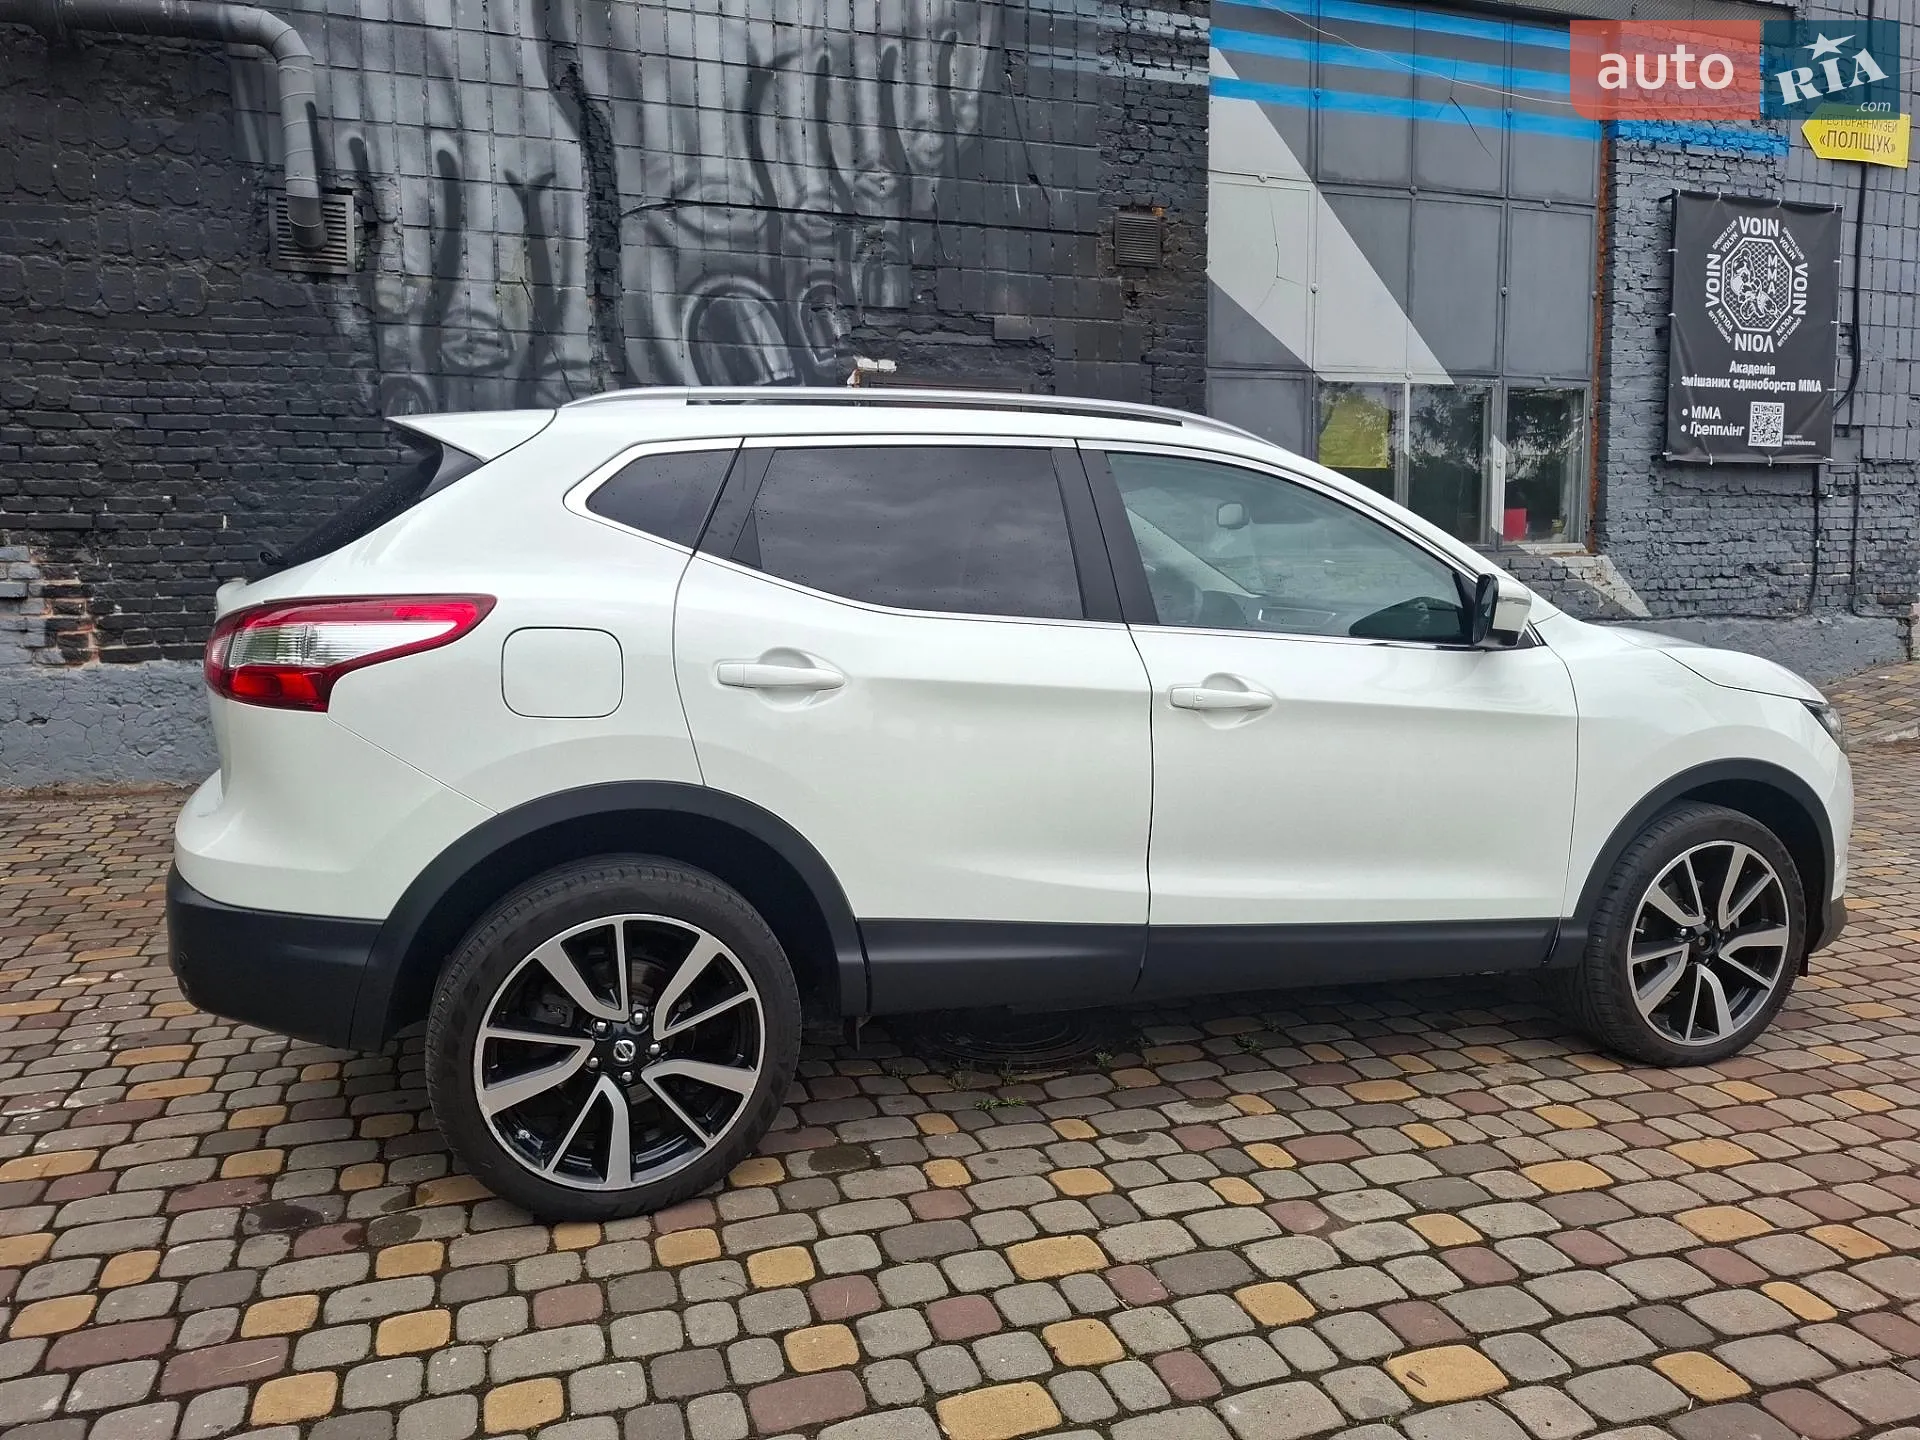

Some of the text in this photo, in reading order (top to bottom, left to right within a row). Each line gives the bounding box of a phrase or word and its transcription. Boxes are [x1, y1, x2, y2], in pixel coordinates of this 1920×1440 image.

[1820, 129, 1896, 155] «ПОЛІЩУК»
[1739, 216, 1779, 237] VOIN
[1720, 231, 1739, 252] VOLYN
[1779, 236, 1797, 260] VOLYN
[1705, 254, 1721, 308] VOIN
[1793, 262, 1809, 315] VOIN
[1734, 333, 1774, 353] VOIN
[1729, 360, 1776, 376] Академія
[1681, 374, 1731, 388] змішаних
[1733, 378, 1796, 394] єдиноборств
[1690, 421, 1745, 437] Грепплінг
